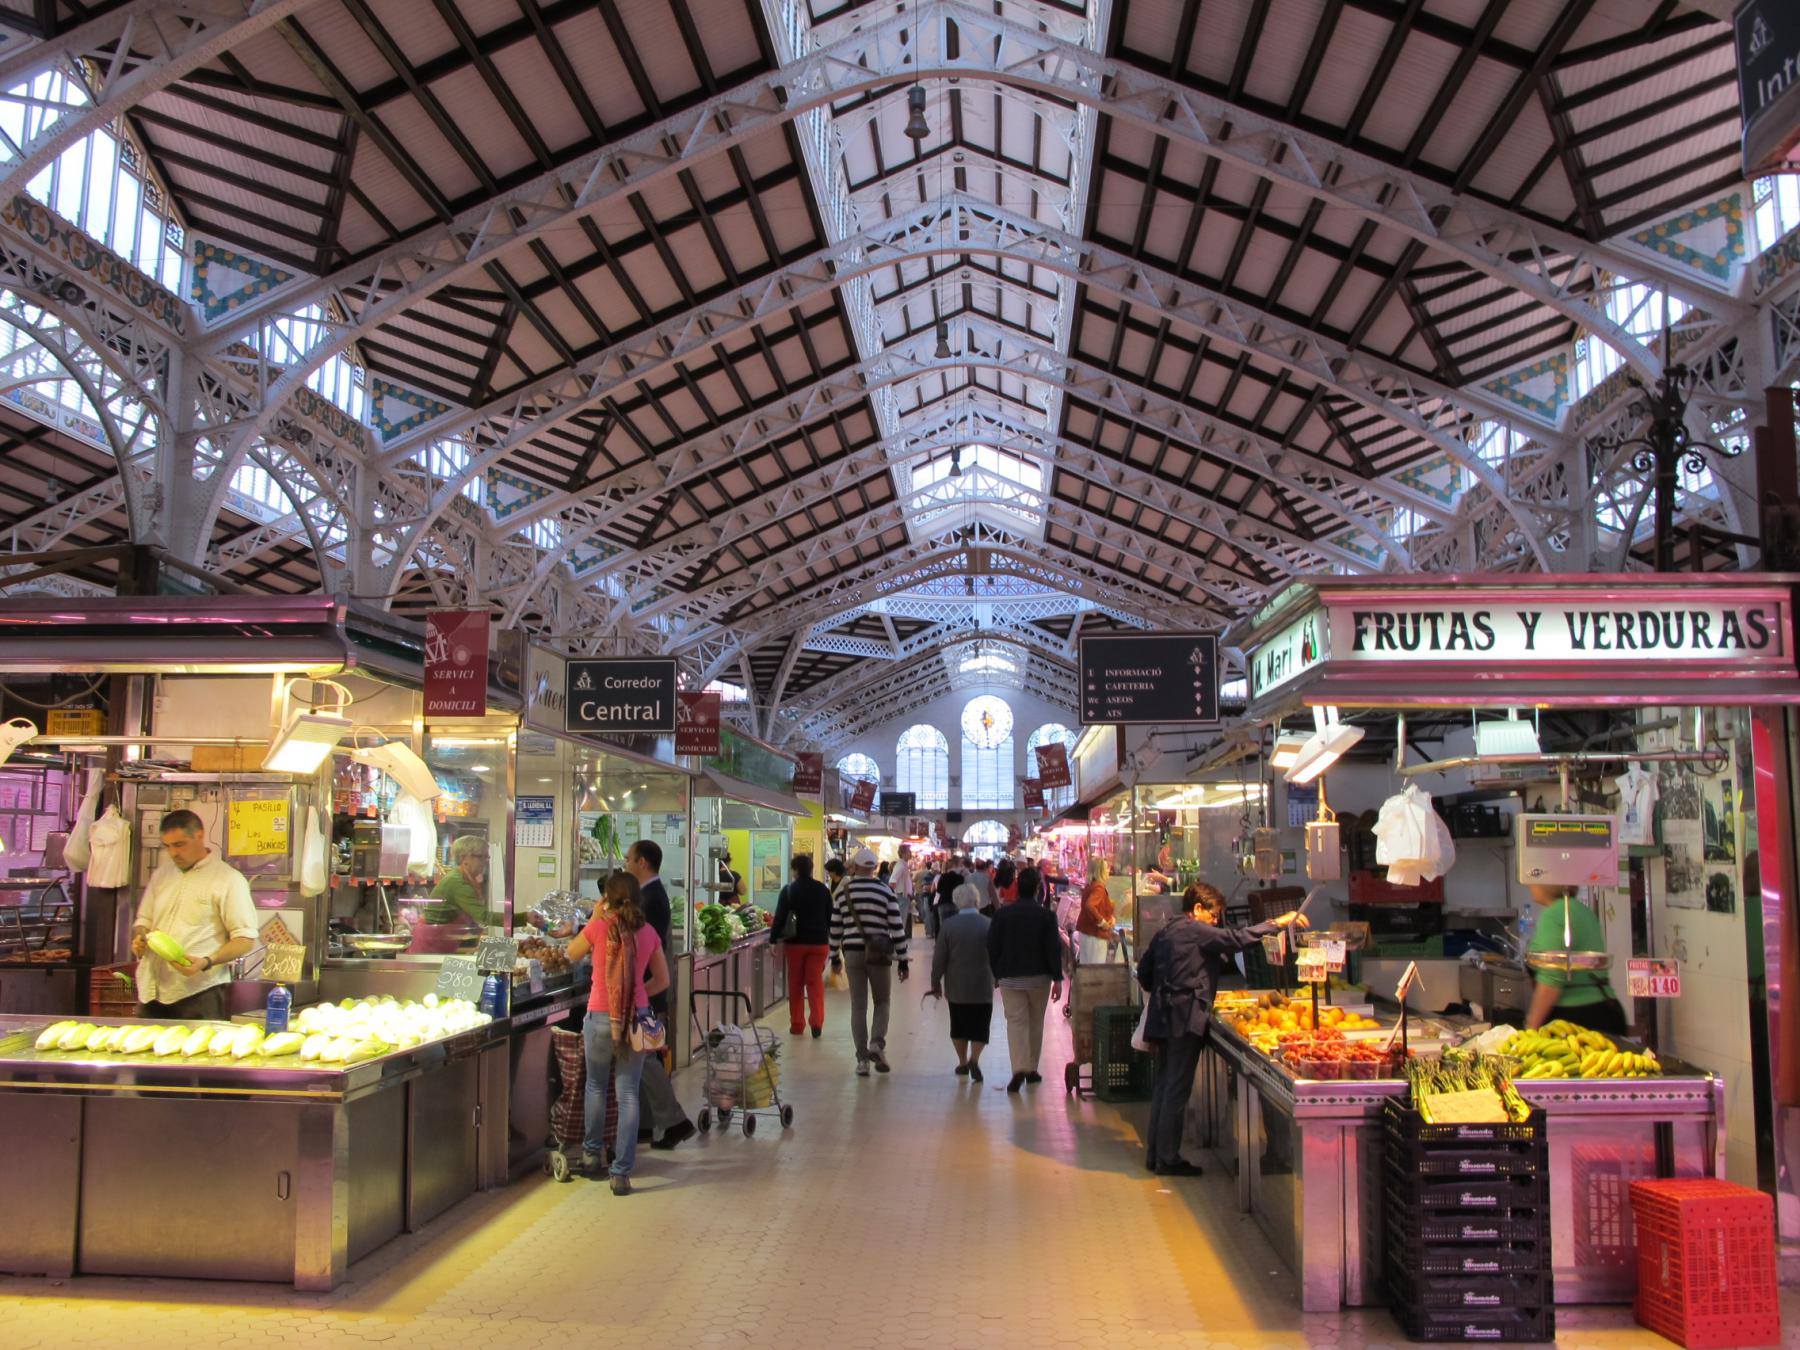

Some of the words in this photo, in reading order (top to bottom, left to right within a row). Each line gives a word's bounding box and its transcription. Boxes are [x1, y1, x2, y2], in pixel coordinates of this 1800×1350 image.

[1352, 611, 1496, 651] FRUTAS
[1517, 611, 1542, 651] Y
[1564, 608, 1770, 650] VERDURAS
[1267, 635, 1293, 686] Mari
[433, 670, 475, 680] SERVICI
[1105, 667, 1162, 677] INFORMACIÓ
[604, 676, 662, 689] Corredor
[1105, 682, 1155, 690] CAFETERIA
[449, 686, 456, 695] A
[1106, 696, 1134, 704] ASEOS
[428, 701, 476, 710] DOMICILI
[580, 700, 661, 721] Central
[1106, 709, 1122, 717] ATS
